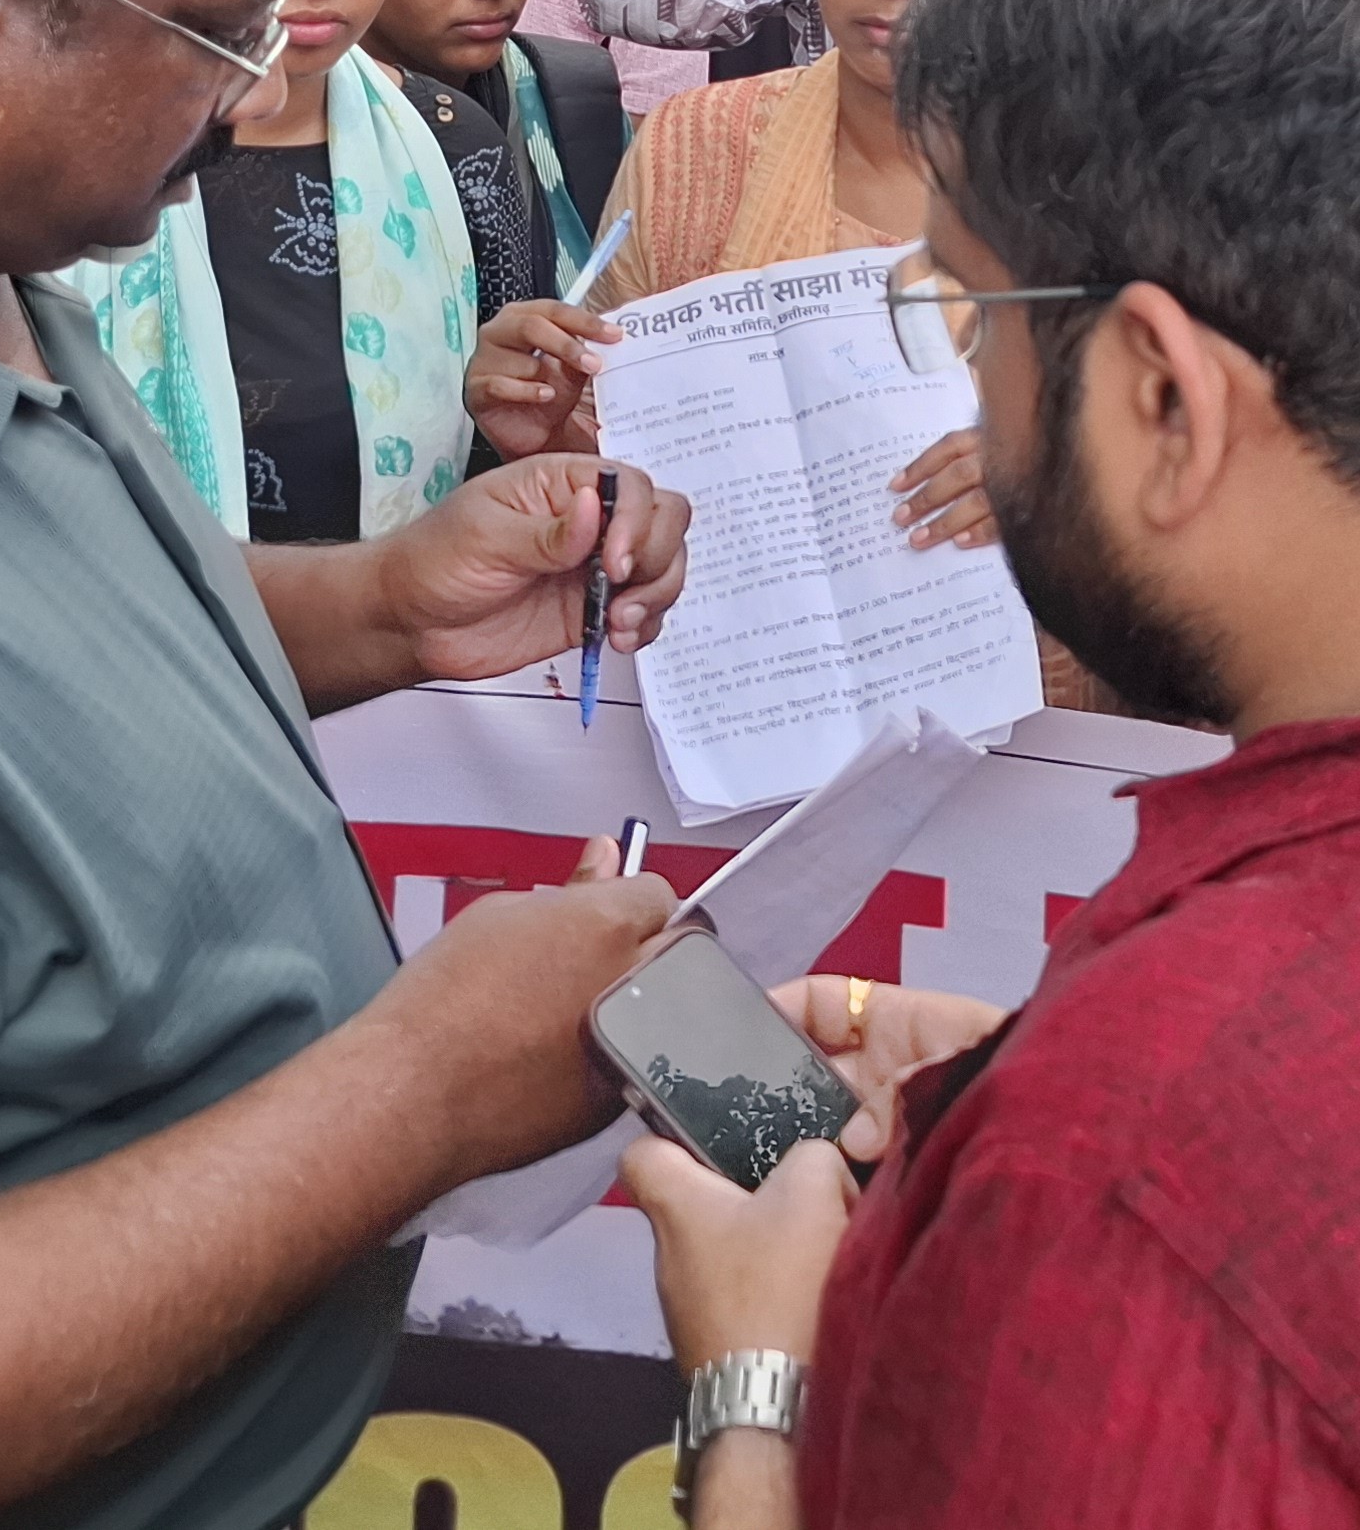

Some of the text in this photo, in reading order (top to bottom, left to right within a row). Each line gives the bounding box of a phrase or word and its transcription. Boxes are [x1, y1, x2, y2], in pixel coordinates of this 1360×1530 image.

[617, 299, 703, 340] शिक्षक
[709, 277, 766, 316] भर्ती
[770, 268, 843, 305] साझा
[686, 303, 830, 345] प्रांतीय समिति, छत्तीसगढ़
